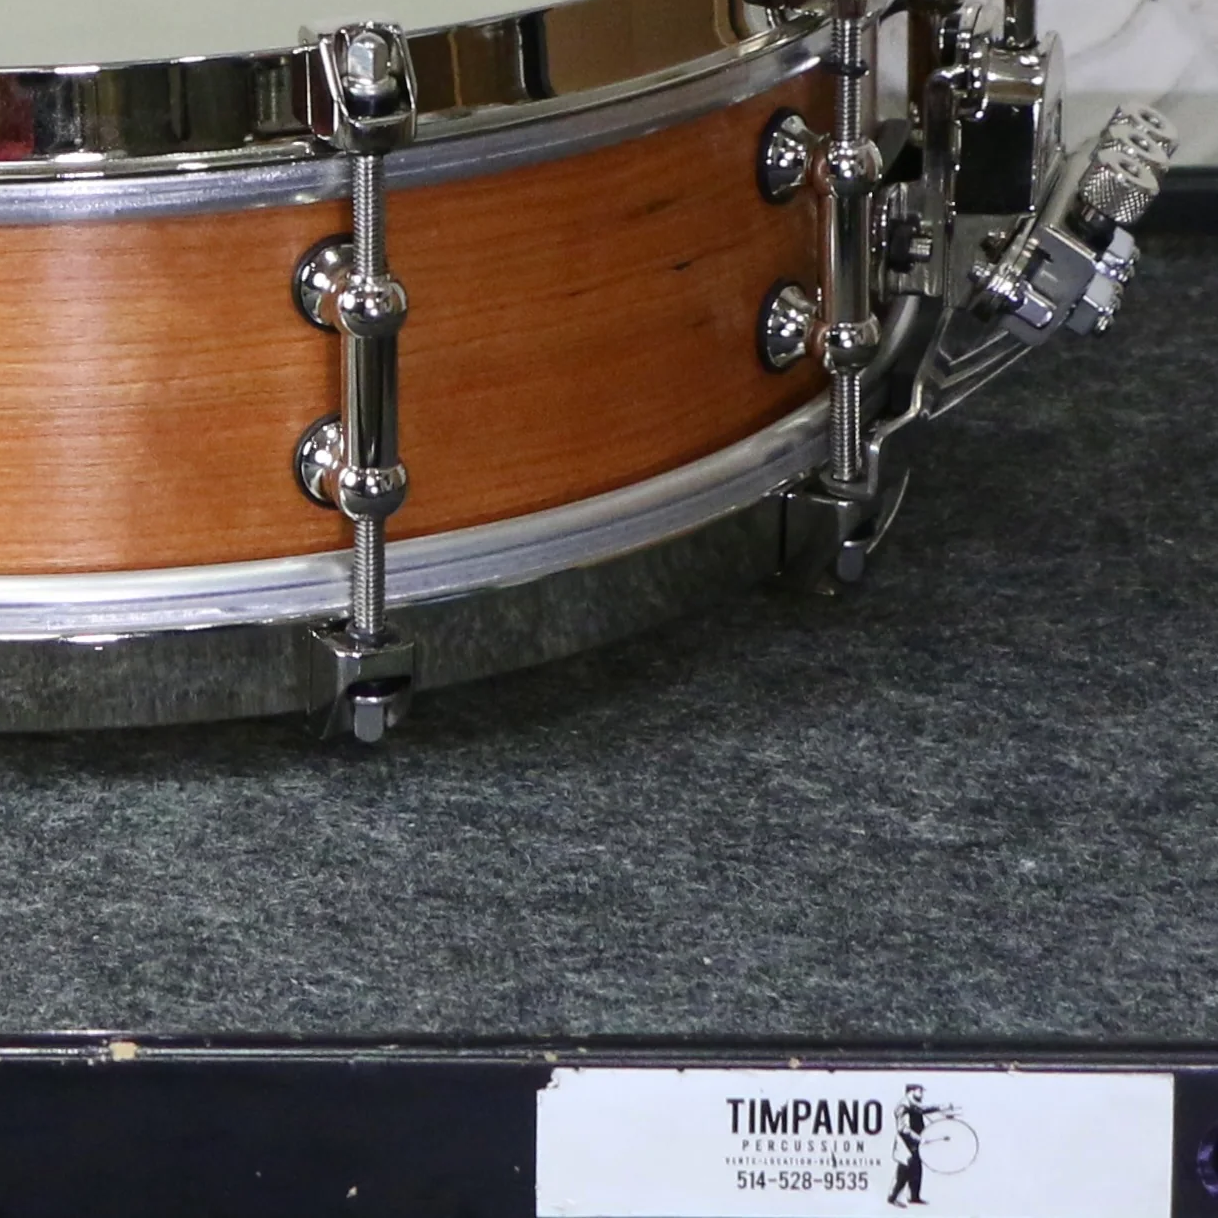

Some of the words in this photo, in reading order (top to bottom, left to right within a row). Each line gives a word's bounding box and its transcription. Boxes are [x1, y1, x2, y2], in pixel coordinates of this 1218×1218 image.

[726, 1098, 883, 1135] TIMPANO
[742, 1139, 865, 1153] PERCUSSION
[736, 1170, 869, 1190] 514-528-9535
